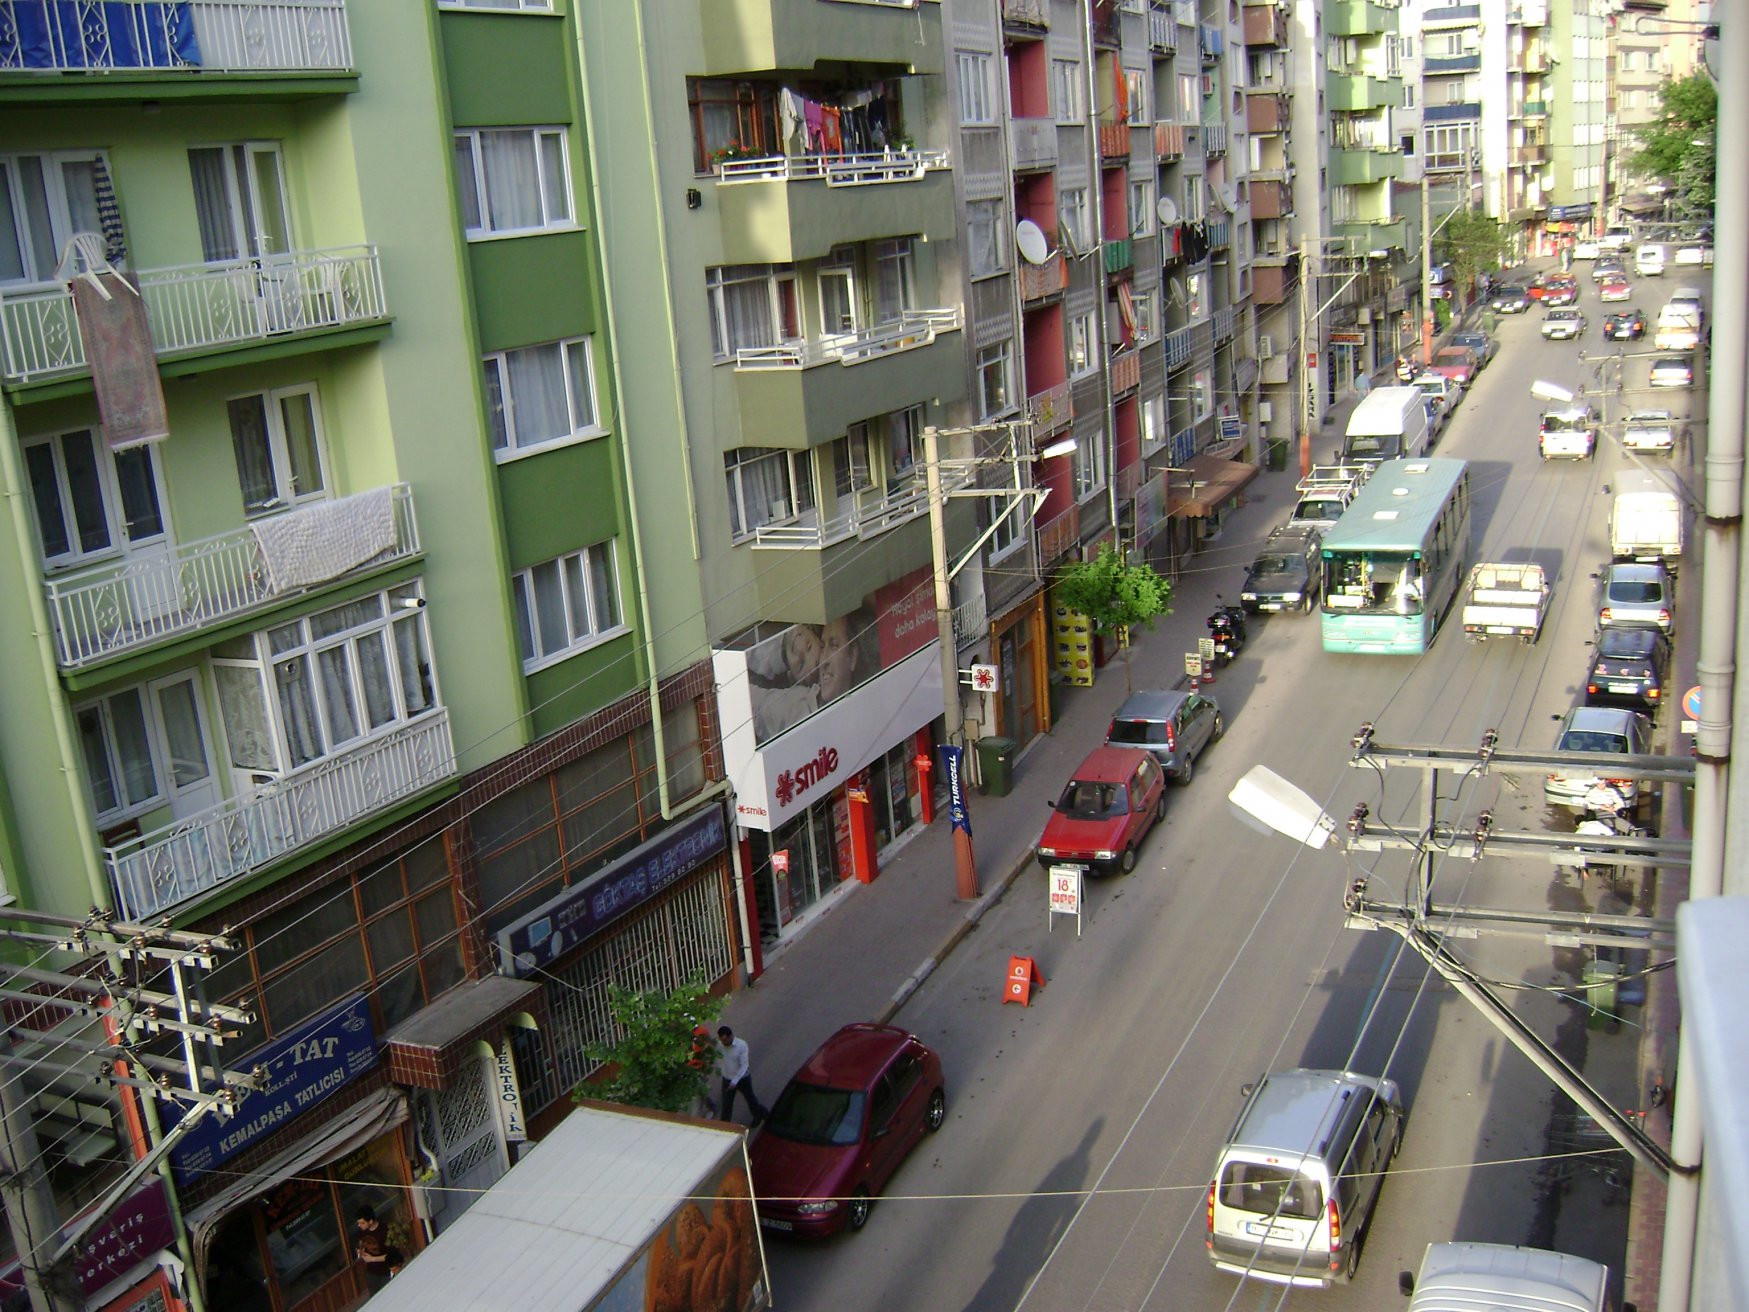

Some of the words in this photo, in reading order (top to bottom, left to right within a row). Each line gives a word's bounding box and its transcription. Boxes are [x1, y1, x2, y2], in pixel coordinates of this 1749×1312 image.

[794, 746, 839, 796] smile
[949, 754, 960, 805] TURKCELL
[745, 806, 767, 817] smile
[1057, 879, 1069, 891] 18
[289, 1037, 339, 1066] TAT
[294, 1067, 345, 1106] TATLICISI
